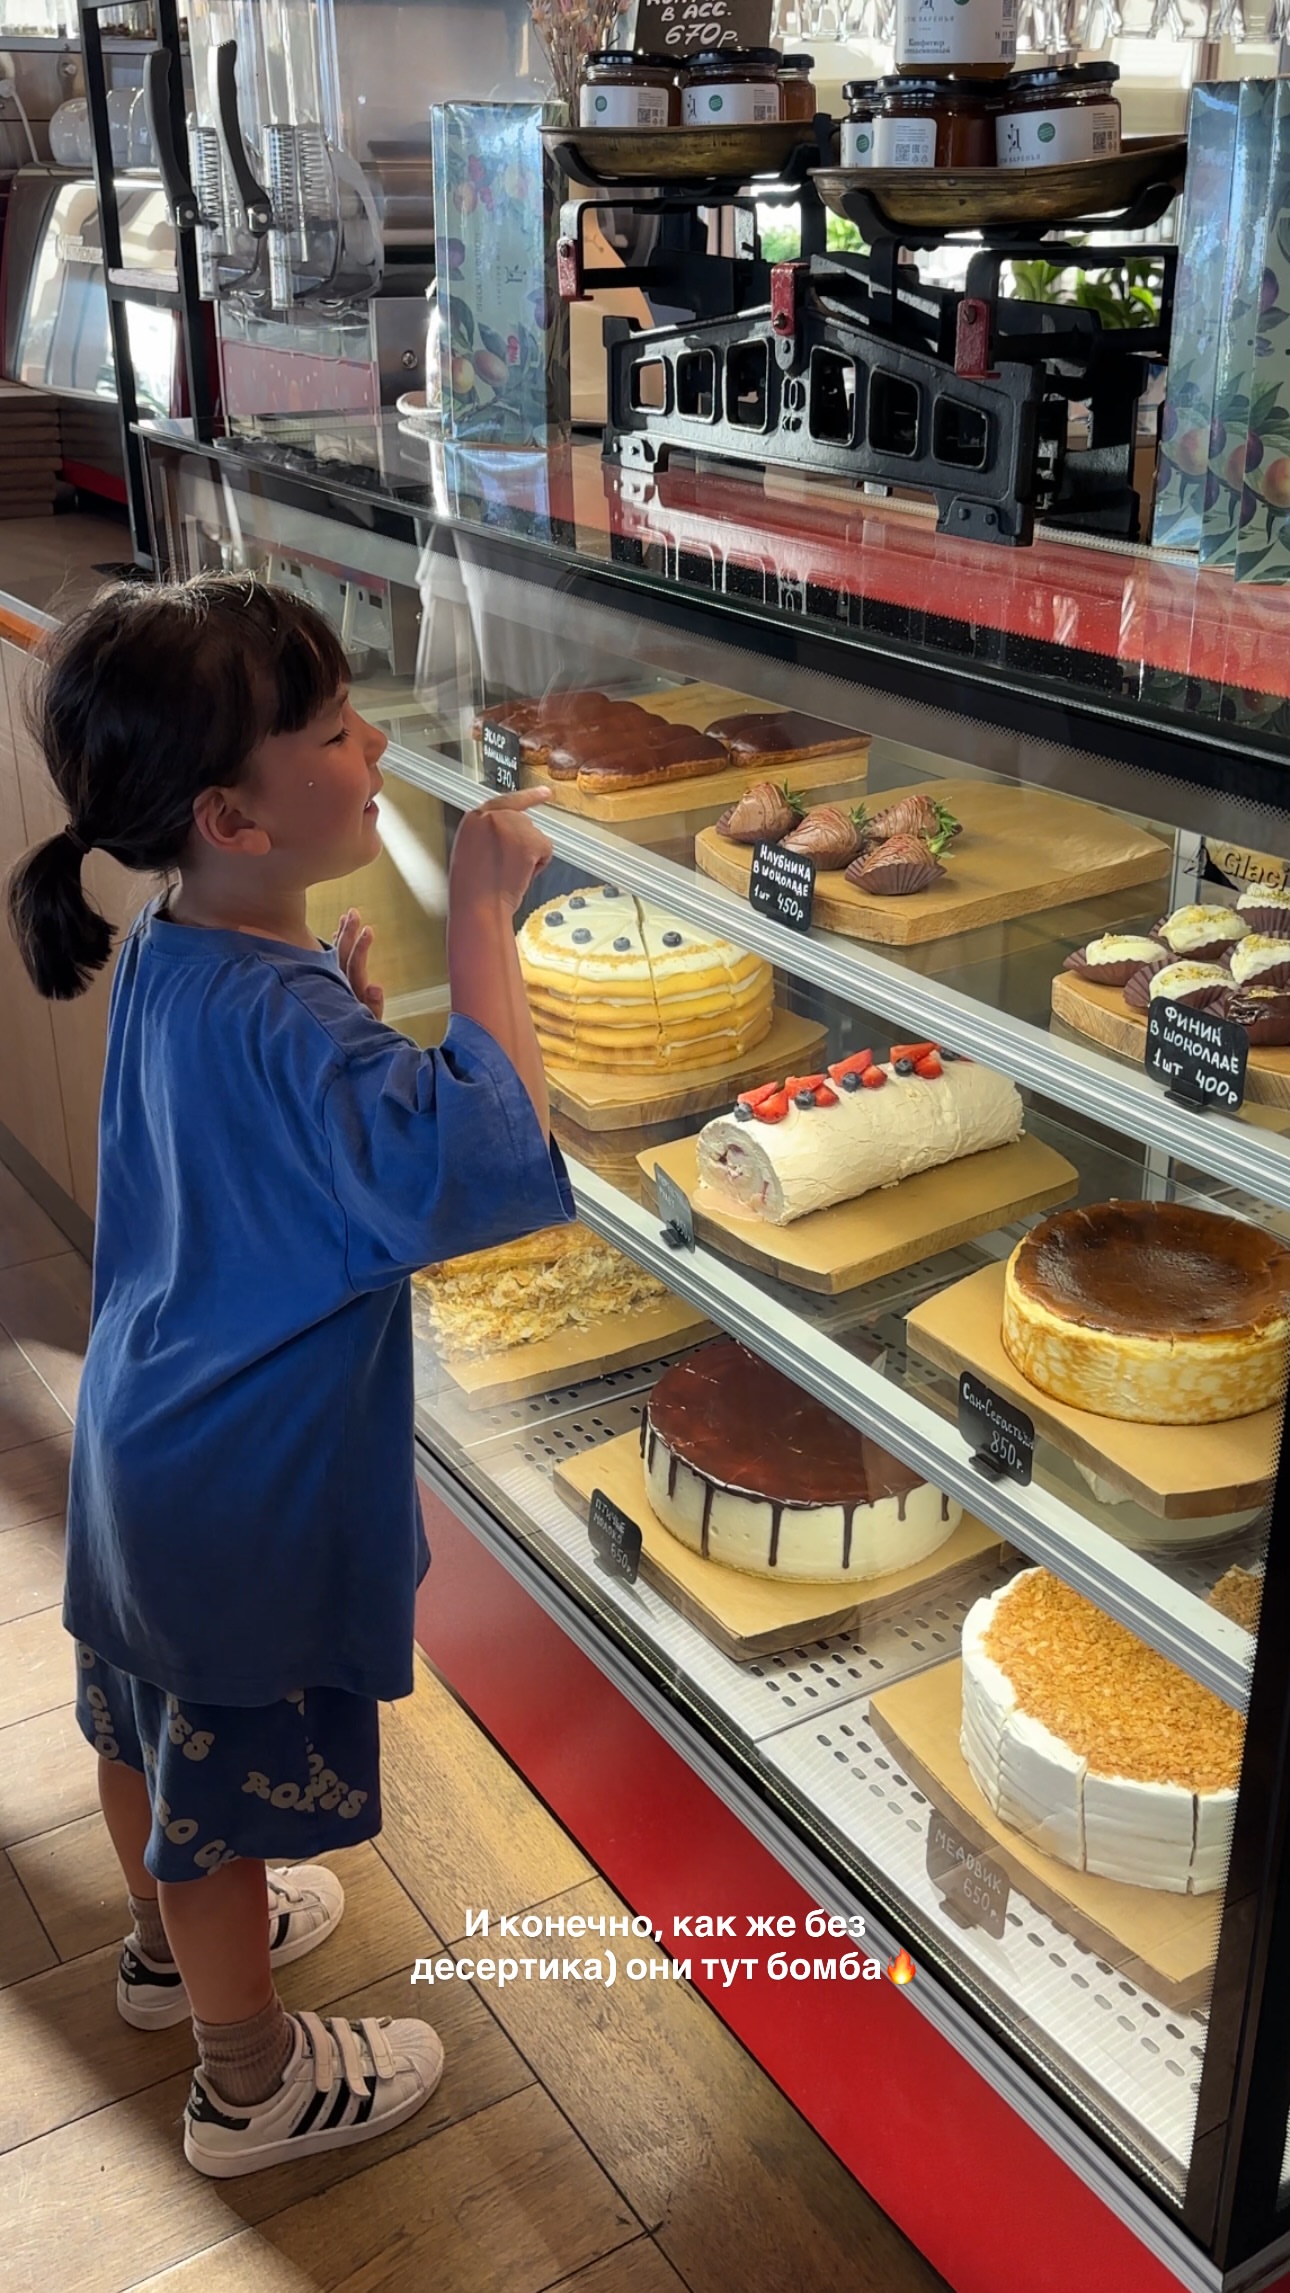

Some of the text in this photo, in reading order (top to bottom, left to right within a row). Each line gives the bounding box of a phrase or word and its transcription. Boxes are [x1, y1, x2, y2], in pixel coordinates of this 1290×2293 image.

[760, 843, 811, 883] КЛУБНИКА
[761, 864, 809, 898] ШОКОЛАДЕ
[1164, 1006, 1222, 1047] ФИНИК
[1163, 1027, 1240, 1075] ШОКОЛАДЕ
[935, 1828, 1001, 1895] МЕДОВИК
